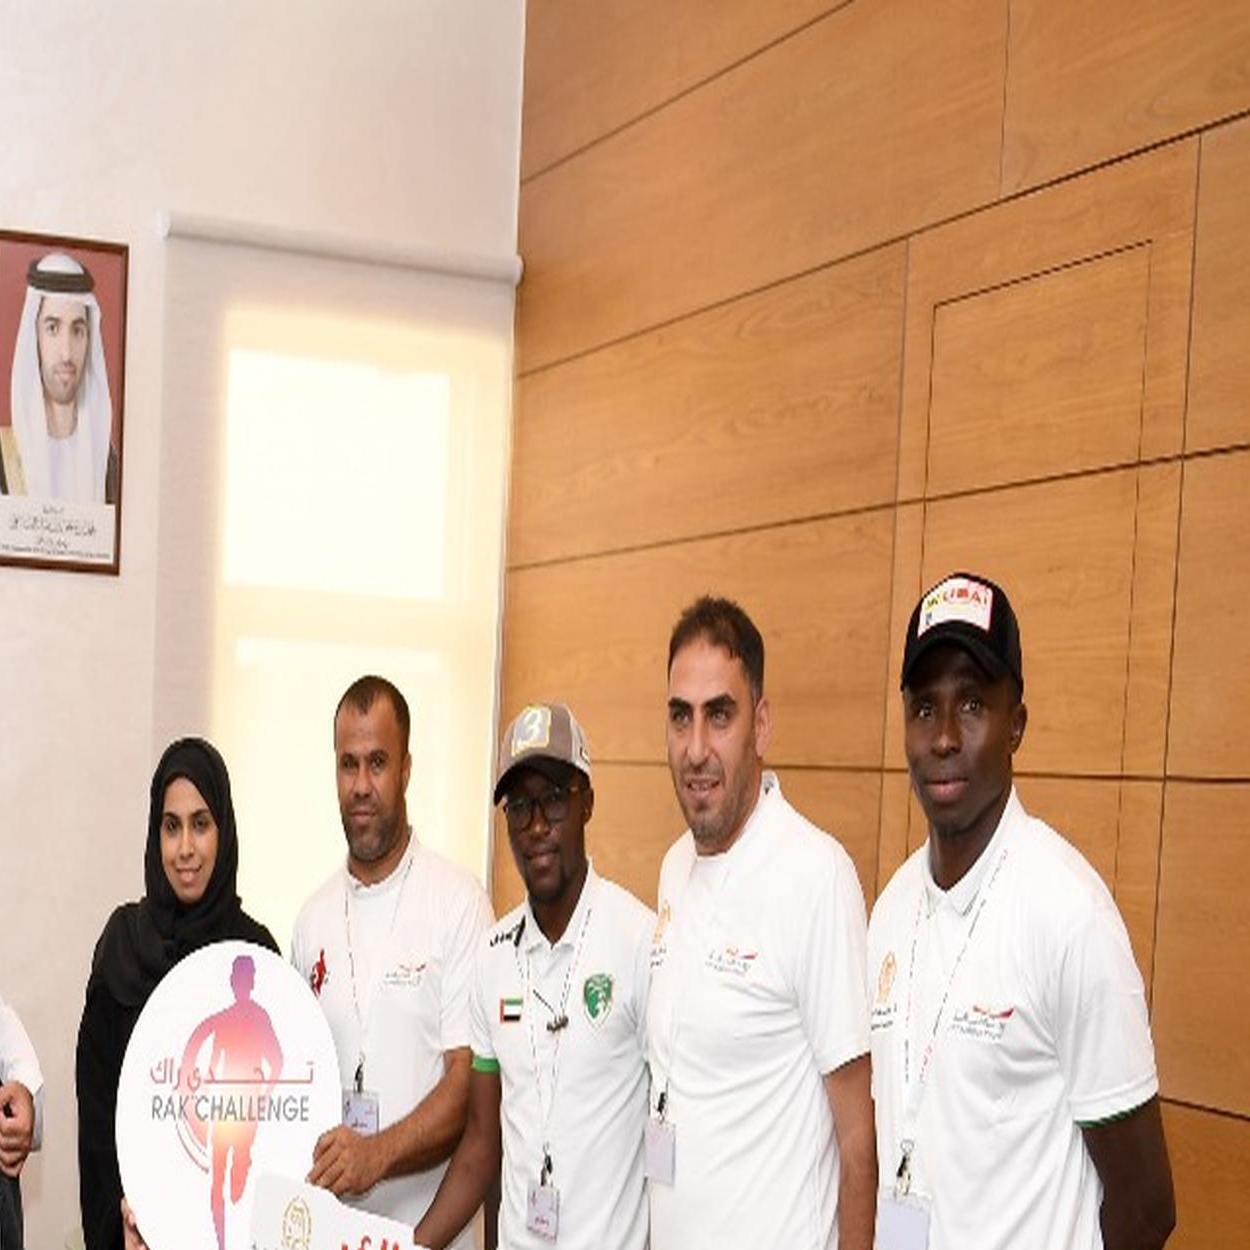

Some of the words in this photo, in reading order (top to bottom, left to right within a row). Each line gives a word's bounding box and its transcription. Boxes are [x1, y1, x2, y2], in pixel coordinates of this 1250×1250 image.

[150, 1057, 181, 1091] راك
[152, 1095, 189, 1121] RAK
[195, 1094, 310, 1122] CHALLENGE
